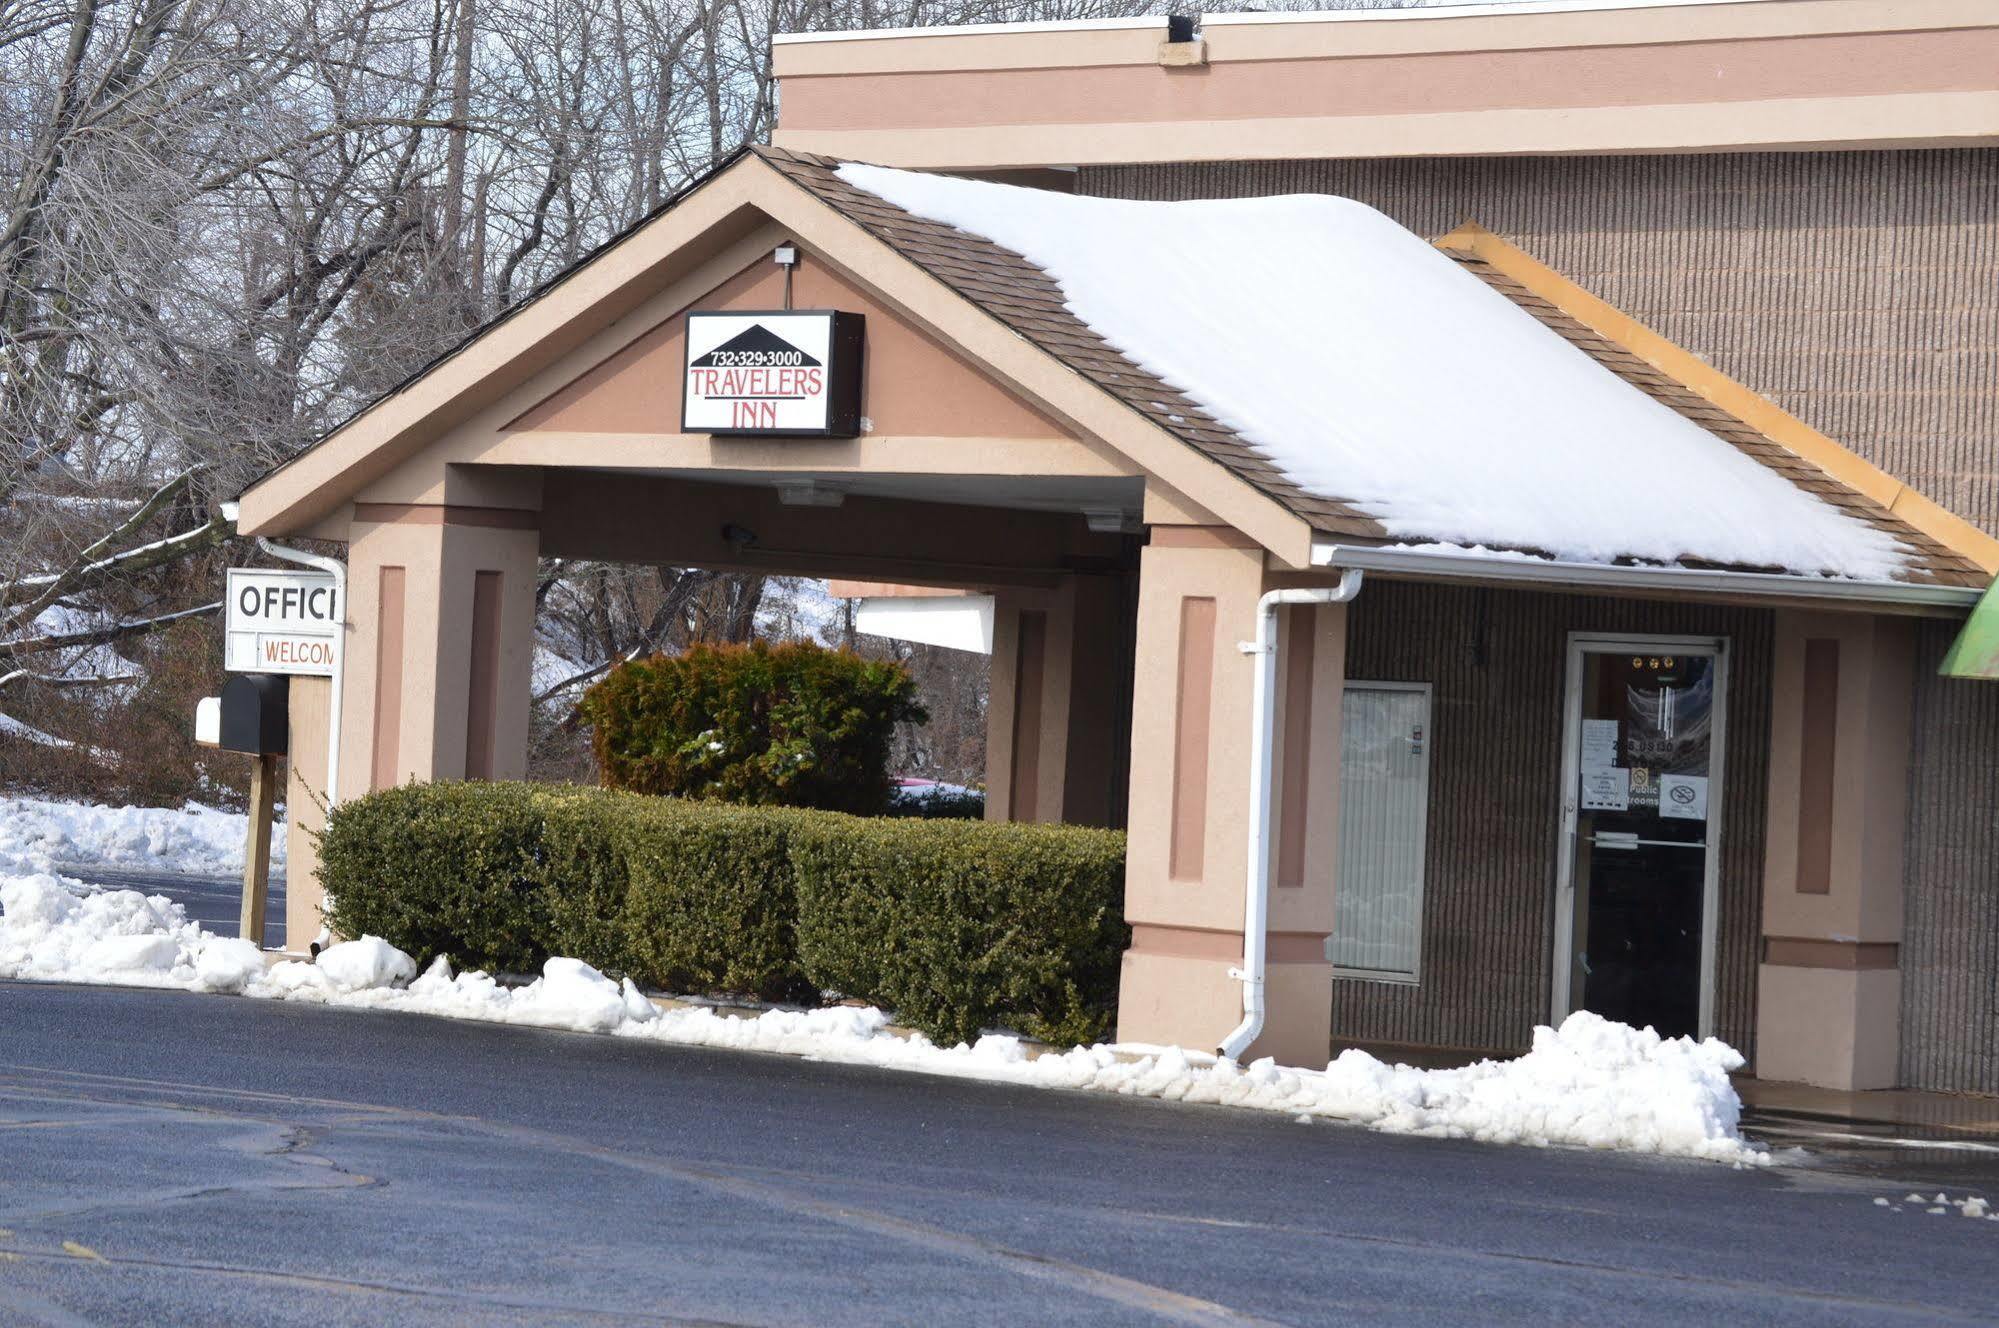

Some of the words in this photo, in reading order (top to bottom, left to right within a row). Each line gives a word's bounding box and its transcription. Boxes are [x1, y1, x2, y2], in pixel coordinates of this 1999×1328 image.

[690, 368, 822, 396] TRAVELERS
[731, 401, 777, 429] INN
[1629, 784, 1658, 795] Public
